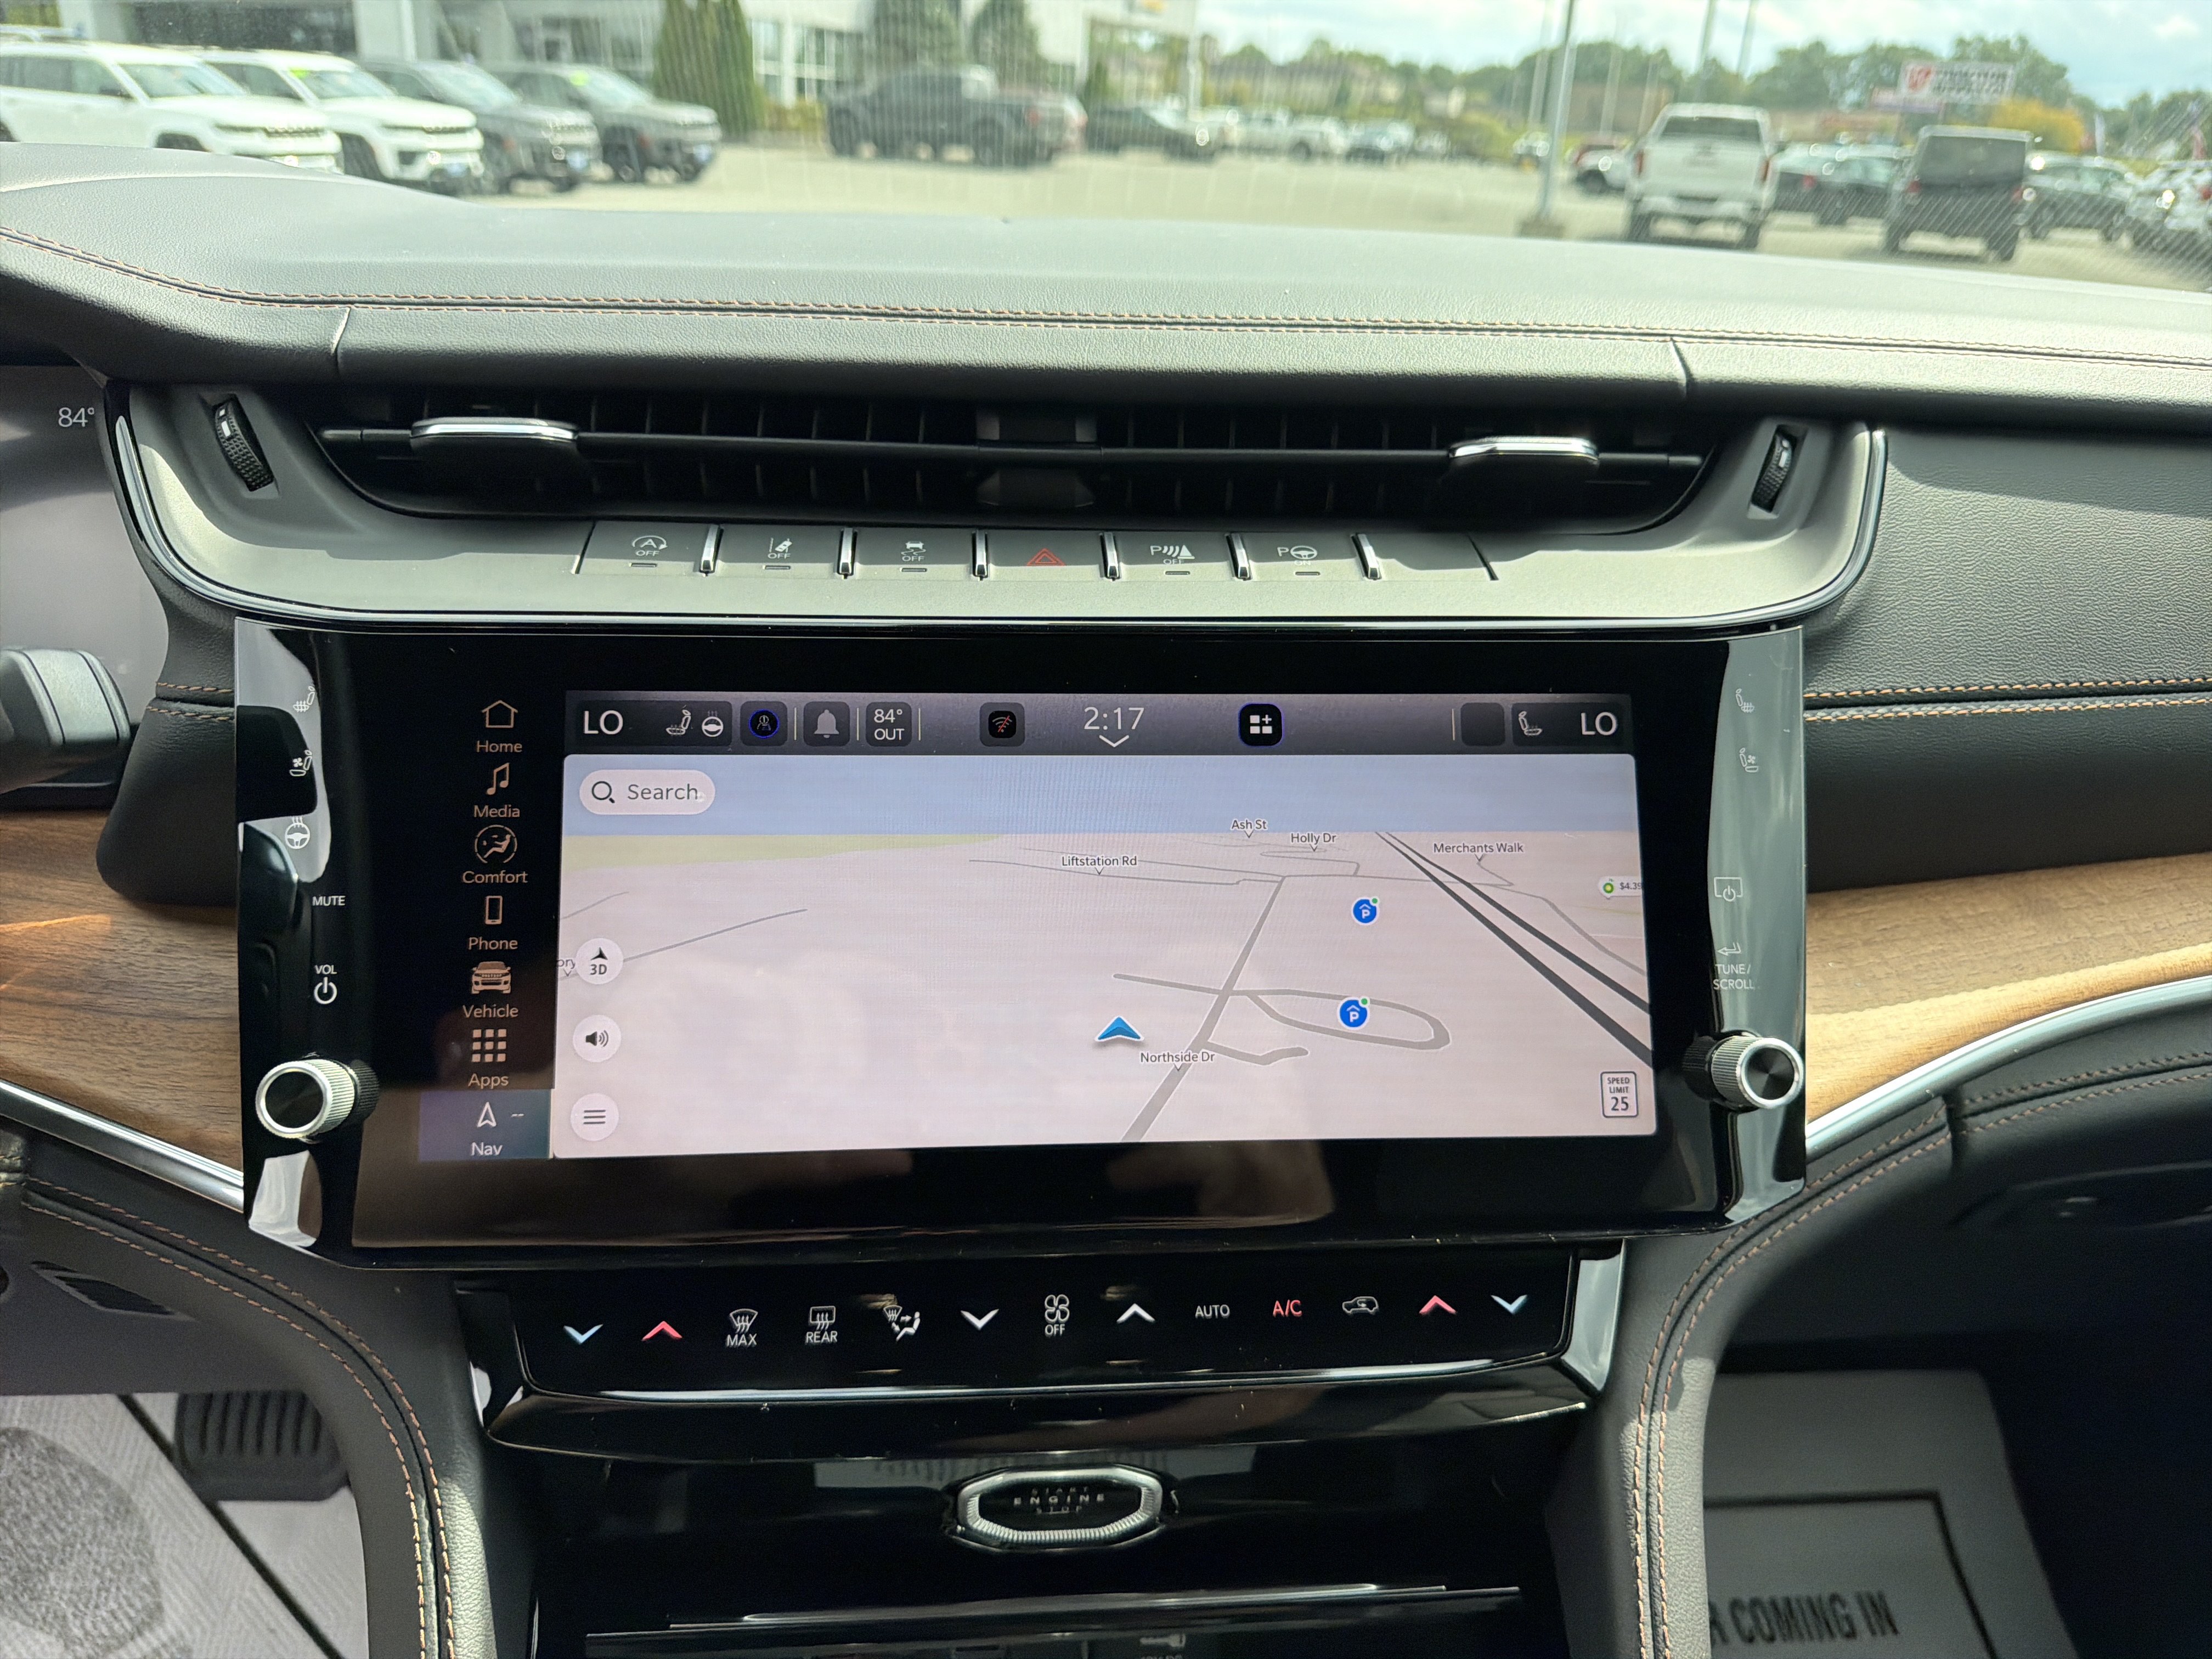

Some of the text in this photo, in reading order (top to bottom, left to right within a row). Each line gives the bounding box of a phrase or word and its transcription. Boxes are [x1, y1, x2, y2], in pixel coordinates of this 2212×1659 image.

[59, 408, 94, 427] 84°
[584, 710, 623, 734] LO
[874, 709, 902, 723] 84°
[1085, 707, 1144, 730] 2:17
[1581, 712, 1617, 735] LO
[874, 729, 904, 740] OUT
[477, 741, 522, 752] Home
[628, 783, 697, 799] Search
[474, 805, 520, 817] Media
[1232, 820, 1266, 829] Ash St
[1291, 833, 1336, 845] Holly Dr
[1434, 843, 1523, 853] Merchants Walk
[1063, 855, 1137, 866] Liftstation Rd
[463, 870, 528, 883] Comfort
[313, 896, 345, 906] MUTE
[469, 937, 517, 950] Phone
[315, 964, 337, 974] VOL
[590, 964, 607, 975] 3D
[1715, 964, 1751, 974] TUNE/
[1713, 979, 1754, 990] SCROLL
[463, 1004, 518, 1018] Vehicle
[1141, 1052, 1215, 1062] Northside Dr
[468, 1074, 509, 1089] Apps
[1611, 1097, 1628, 1111] 25
[471, 1142, 503, 1155] Nav
[1195, 1305, 1229, 1317] AUTO
[1273, 1300, 1301, 1316] A/C
[1045, 1324, 1065, 1335] OFF
[727, 1334, 757, 1346] MAX
[806, 1331, 837, 1342] REAR
[1014, 1494, 1104, 1505] ENGINE
[1729, 1593, 1857, 1644] COMING
[1857, 1590, 1900, 1637] IN
